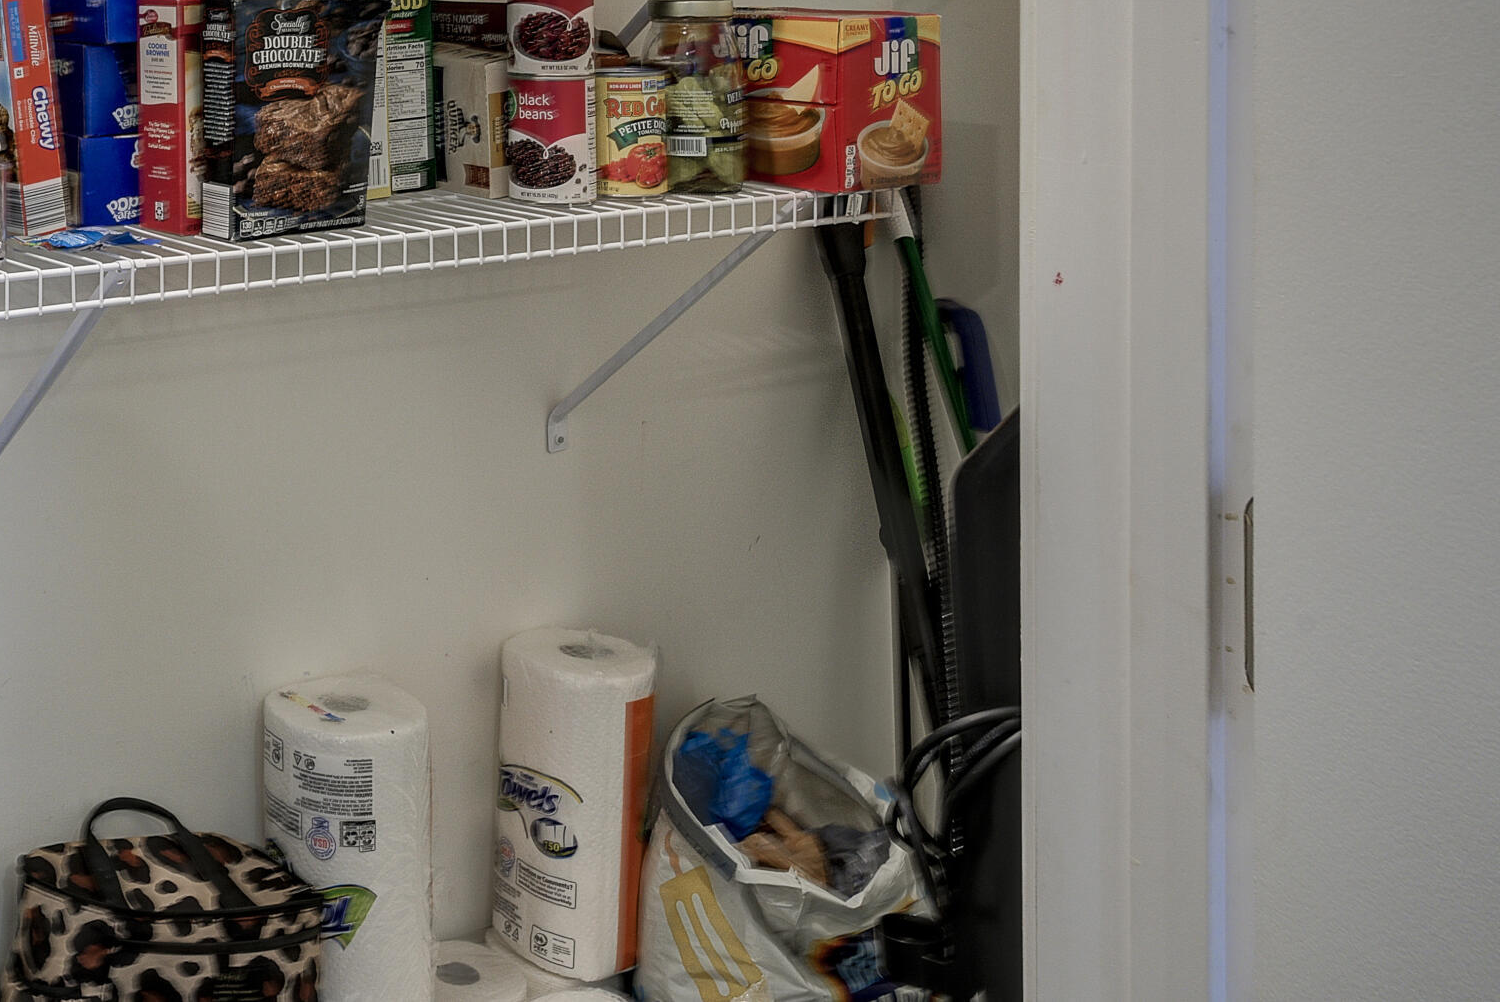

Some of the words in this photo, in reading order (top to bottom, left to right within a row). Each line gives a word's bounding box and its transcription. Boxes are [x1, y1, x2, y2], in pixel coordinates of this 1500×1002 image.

[452, 13, 484, 25] BROWN
[844, 22, 869, 33] CREAMY
[202, 30, 231, 40] CHOCOLATE
[27, 24, 41, 68] Millville
[148, 42, 168, 50] COOKIE
[263, 35, 313, 49] DOUBLE
[407, 42, 424, 50] Facts
[145, 49, 171, 58] BROWNIE
[252, 48, 321, 65] CHOCOLATE
[873, 39, 916, 77] Jif
[258, 63, 282, 71] PREMIUM
[870, 83, 896, 108] TO
[897, 69, 924, 96] GO
[518, 93, 550, 106] black
[26, 98, 35, 128] Chocolate
[518, 107, 554, 120] beans
[603, 97, 645, 119] RED
[31, 85, 56, 151] Chewy
[617, 119, 653, 137] PETITE
[311, 837, 330, 849] USA
